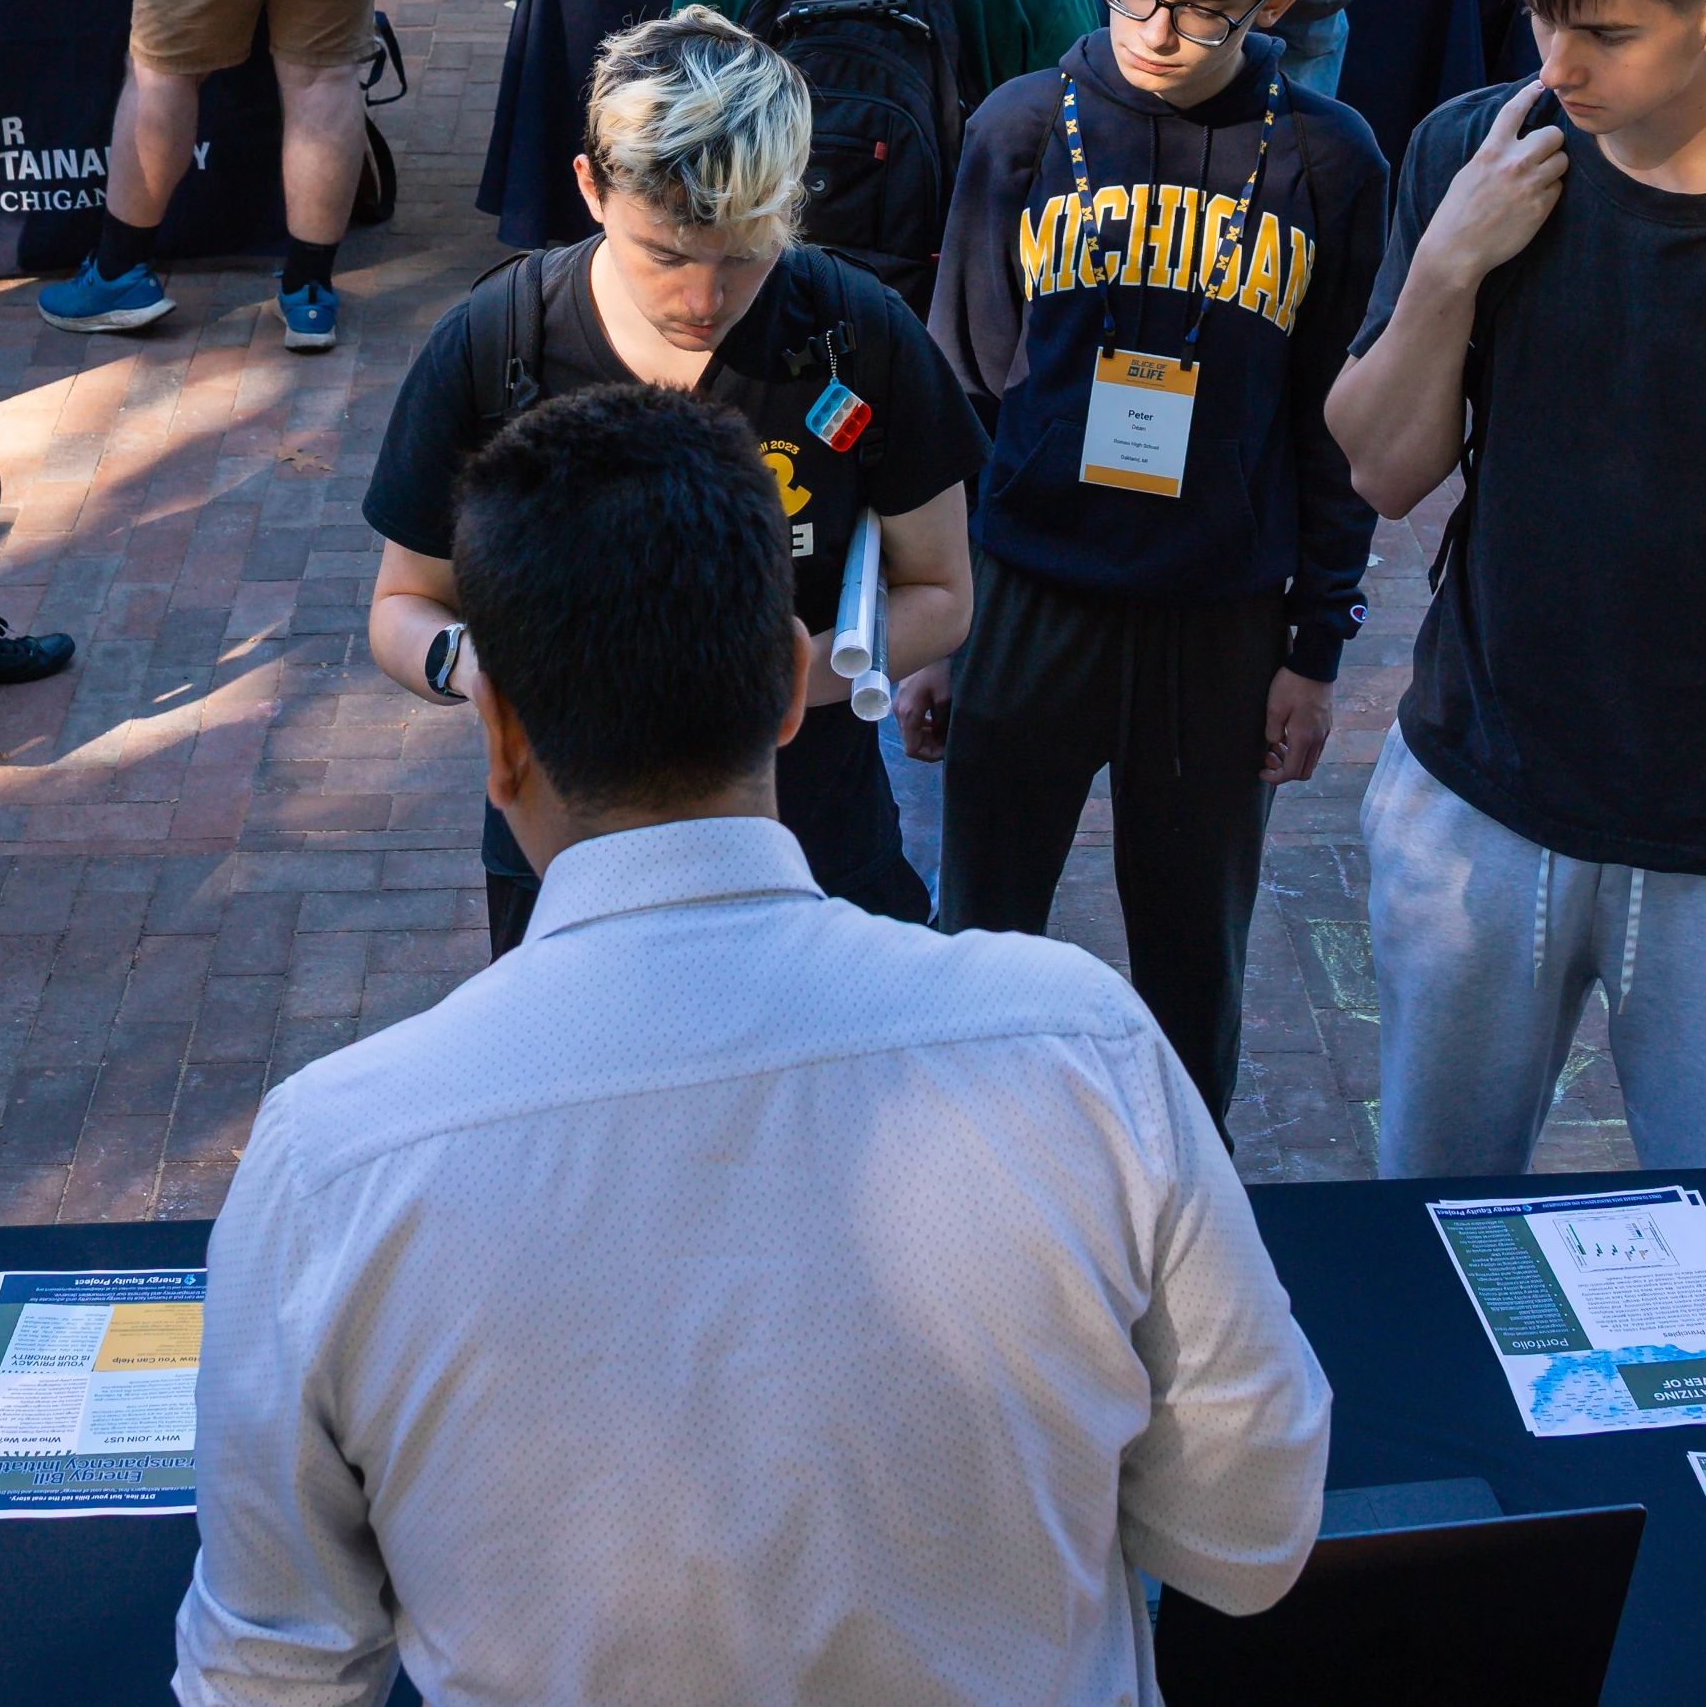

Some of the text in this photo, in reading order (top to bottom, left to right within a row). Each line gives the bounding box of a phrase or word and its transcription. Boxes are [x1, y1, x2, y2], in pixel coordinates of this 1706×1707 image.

[1020, 184, 1316, 338] MICHIGAN
[1139, 367, 1167, 381] LIFE
[1128, 409, 1154, 422] Peter
[1131, 424, 1147, 432] Dean
[770, 440, 801, 455] 2023
[1436, 1205, 1522, 1217] Energy Equity Project
[75, 1276, 182, 1286] Energy Equity Project
[1662, 1328, 1706, 1339] Principles
[1512, 1337, 1569, 1350] Portfolio
[10, 1359, 54, 1367] PRIVACY
[111, 1355, 135, 1364] Help
[135, 1356, 156, 1364] Can
[156, 1355, 177, 1364] You
[1661, 1379, 1681, 1391] OF
[38, 1436, 61, 1444] Who
[104, 1435, 180, 1444] WHY JOIN US?
[65, 1454, 195, 1471] ransparency
[32, 1470, 143, 1485] Energy Bill
